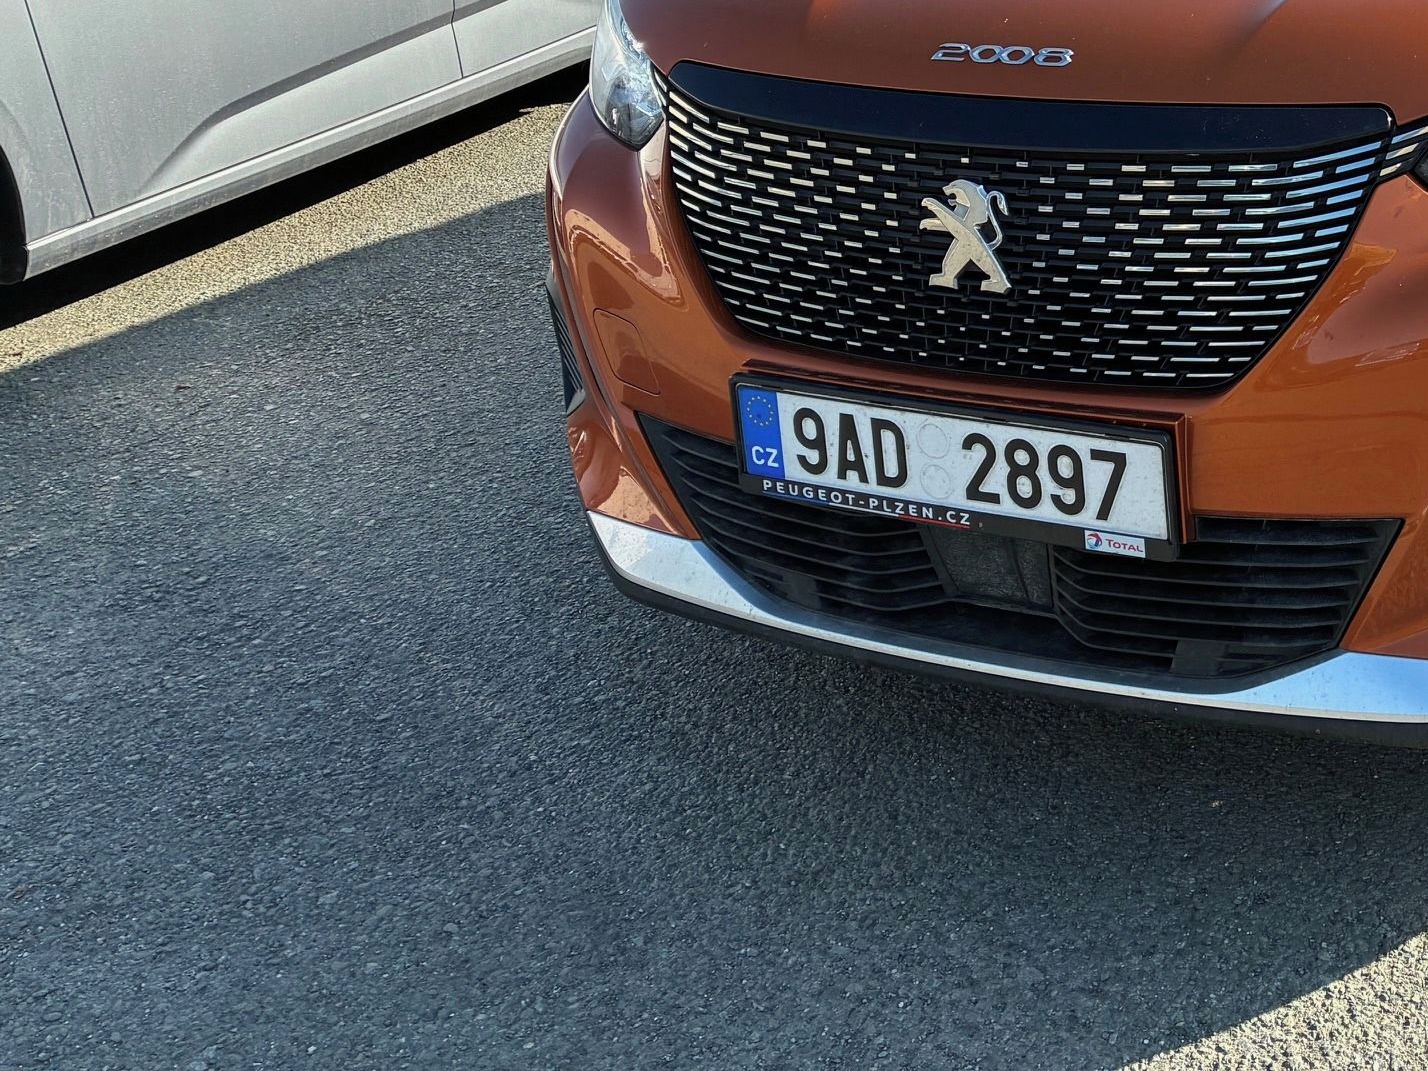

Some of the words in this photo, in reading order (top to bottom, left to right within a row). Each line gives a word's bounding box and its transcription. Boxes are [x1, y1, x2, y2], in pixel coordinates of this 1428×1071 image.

[930, 42, 1075, 67] 2008
[751, 445, 779, 467] CZ
[793, 407, 908, 489] 9AD
[961, 432, 1127, 521] 2897
[762, 479, 971, 525] PEUGEOT-PLZEN.CZ
